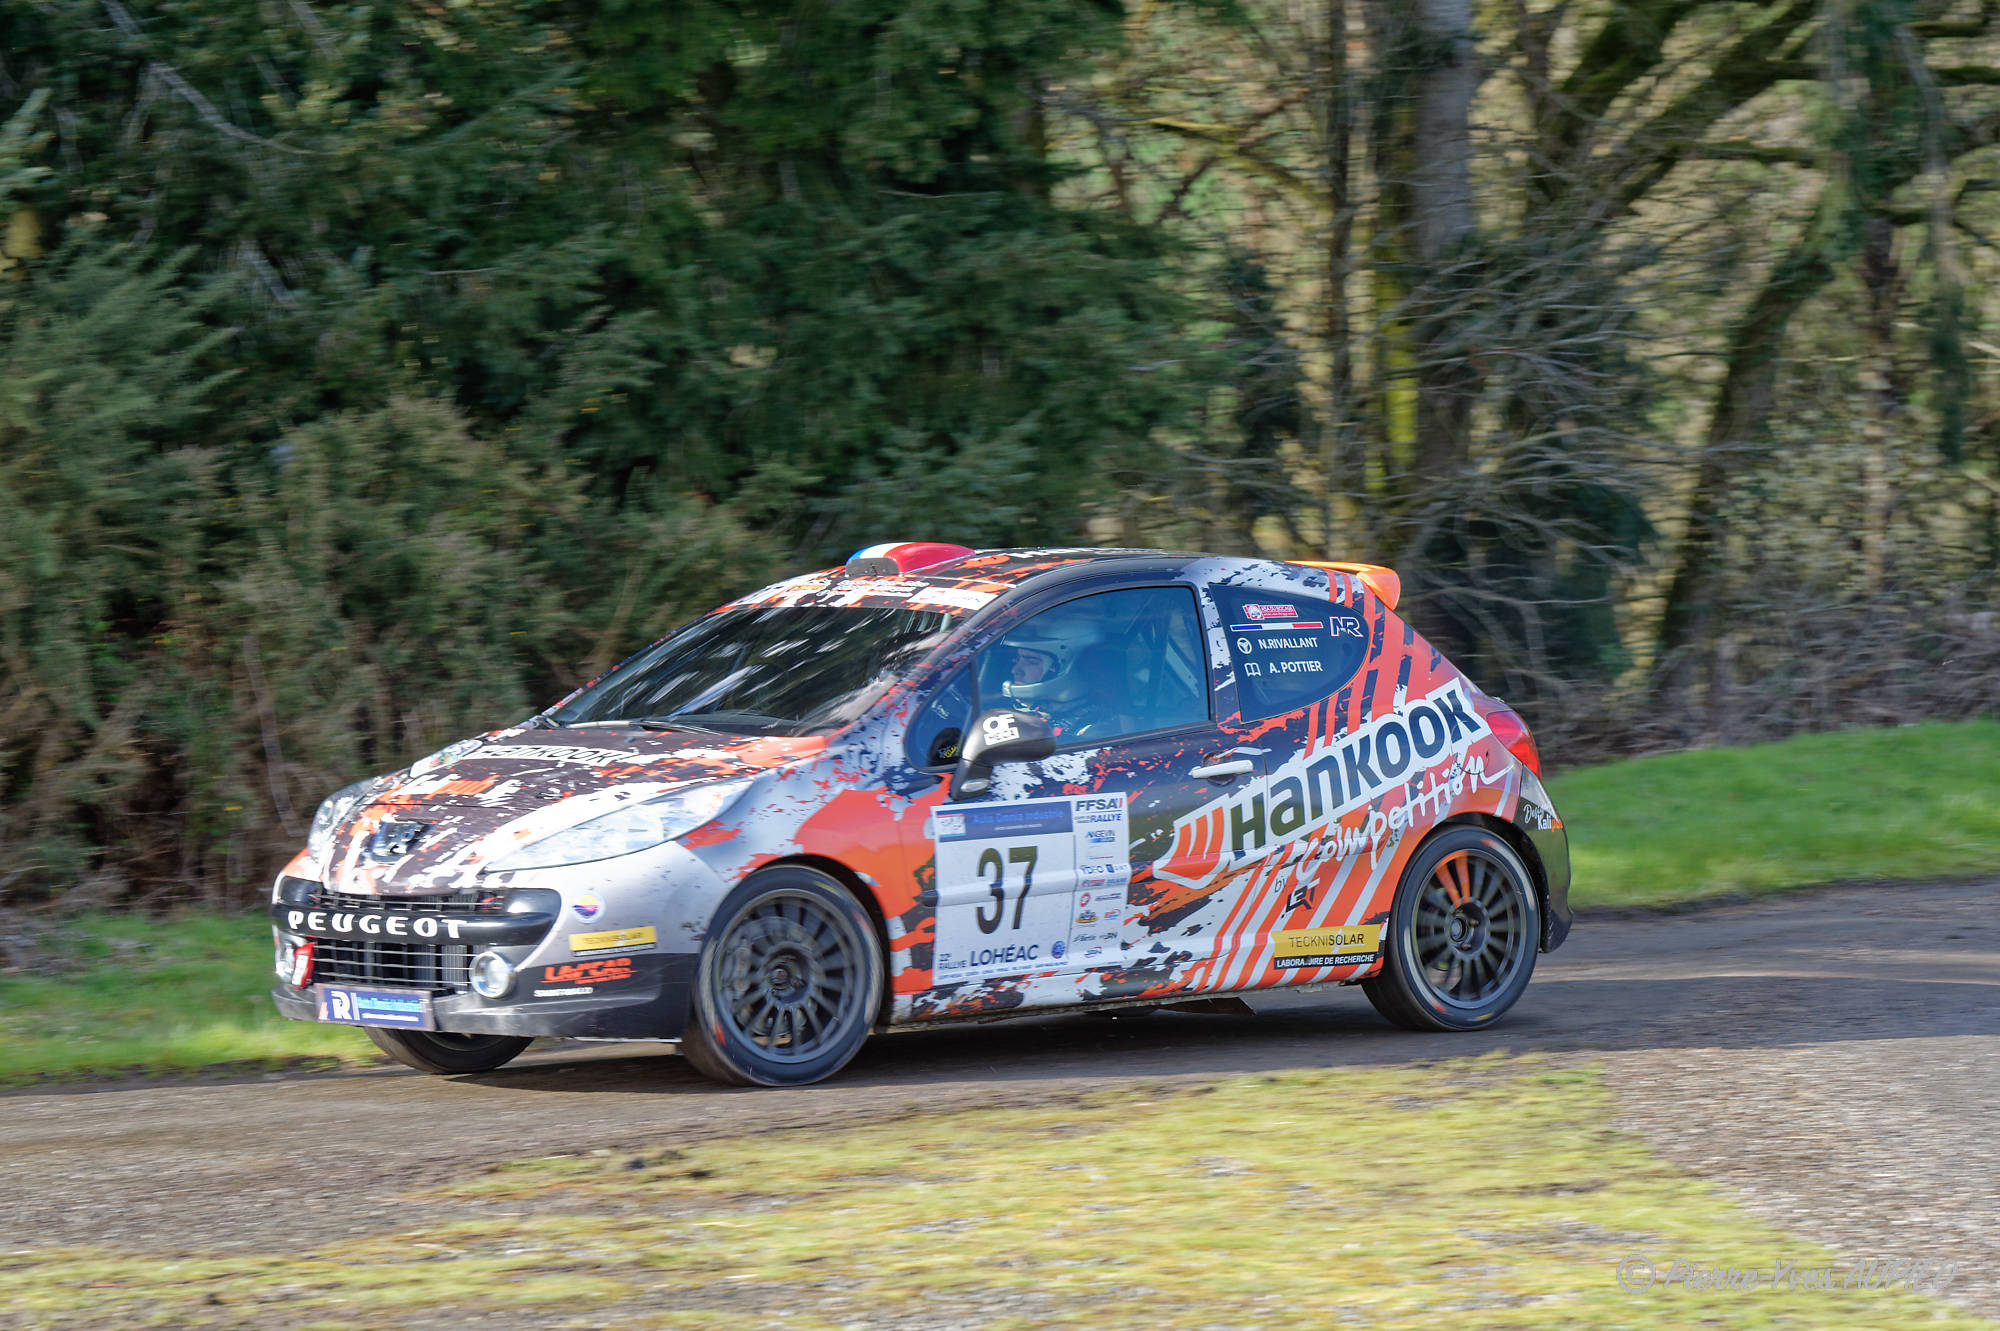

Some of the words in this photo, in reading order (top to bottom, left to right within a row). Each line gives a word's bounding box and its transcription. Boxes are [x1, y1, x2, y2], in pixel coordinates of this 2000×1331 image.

[1257, 637, 1319, 650] N.RIVALLANT
[1269, 662, 1280, 674] A.
[1281, 660, 1323, 674] POTTIER
[1075, 798, 1118, 812] FFSA
[1090, 813, 1122, 823] RALLYE
[976, 845, 1039, 935] 37
[1274, 876, 1289, 893] by
[287, 910, 467, 939] PEUGEOT
[1288, 933, 1365, 948] TECKNISOLAR
[969, 943, 1039, 967] LOHÉAC
[1324, 956, 1334, 965] DE
[1335, 953, 1375, 965] RECHERCHE
